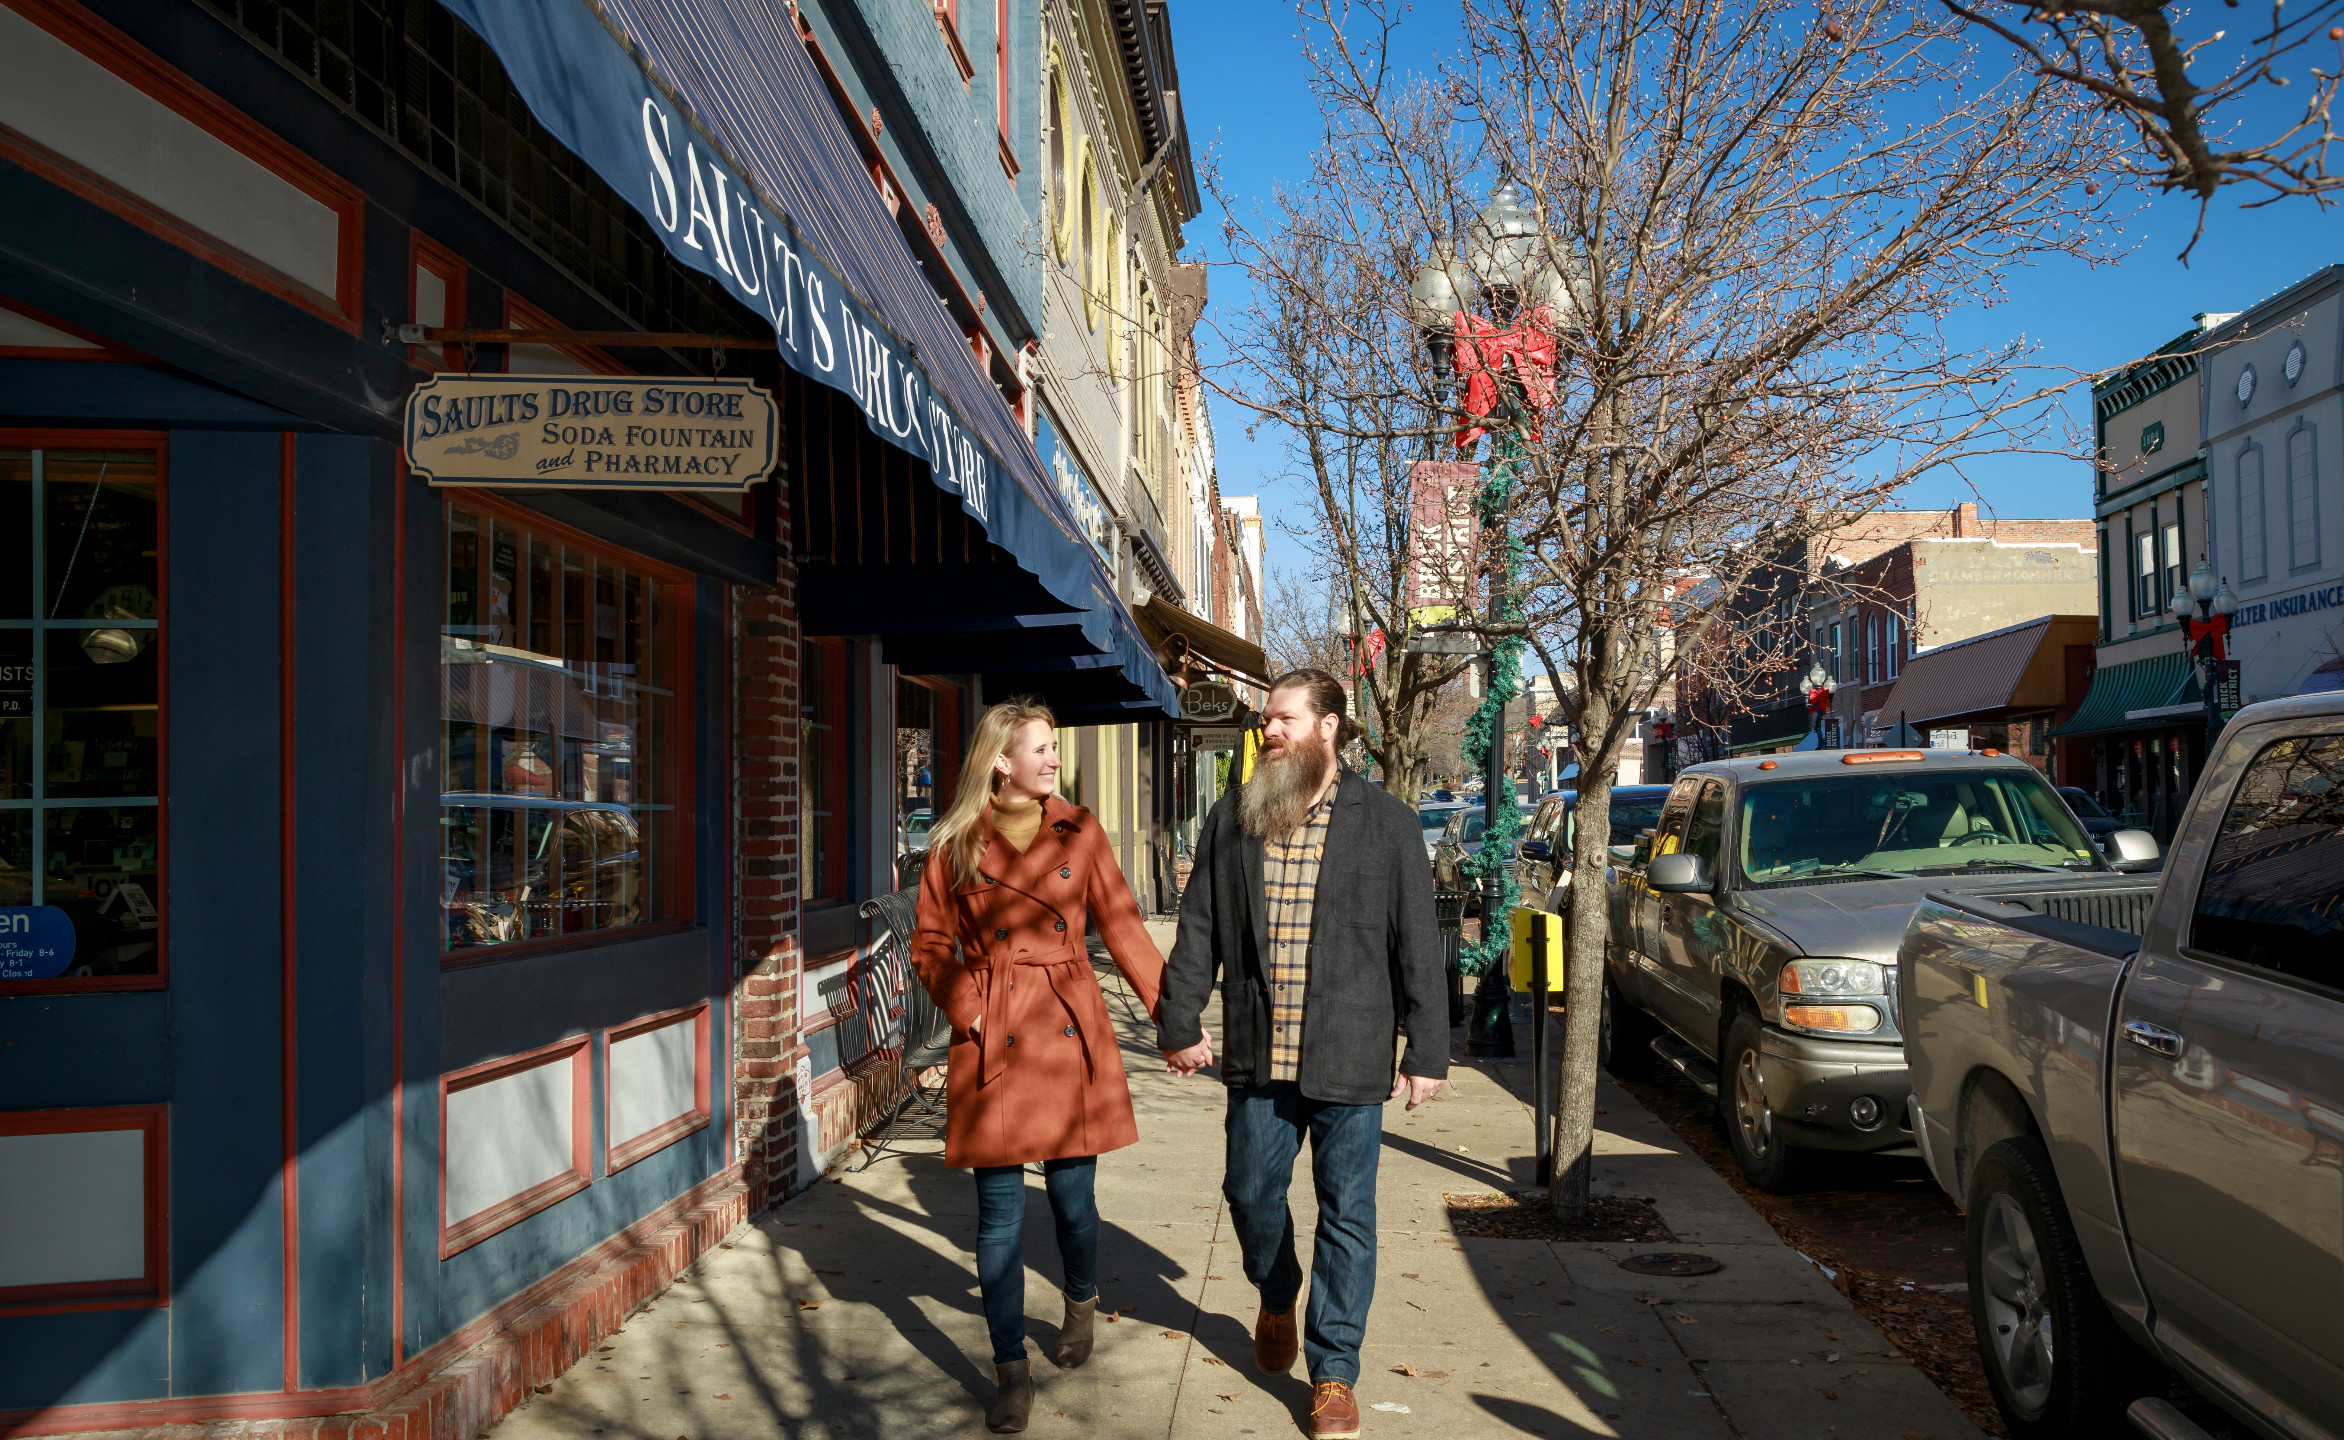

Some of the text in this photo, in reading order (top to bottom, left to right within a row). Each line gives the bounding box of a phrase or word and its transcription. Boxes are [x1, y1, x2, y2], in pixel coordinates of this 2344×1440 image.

[643, 98, 835, 373] SAULTS
[417, 388, 746, 440] SAULTS DRUG STORE
[541, 422, 754, 449] SODA FOUNTAIN
[535, 448, 742, 475] and PHARMACY
[2269, 585, 2344, 621] INSURANCE
[1186, 689, 1229, 714] Beks
[2220, 682, 2230, 709] BRICK
[2228, 668, 2239, 709] DISTRICT
[6, 950, 33, 958] Friday
[39, 949, 55, 957] 8-6
[9, 958, 23, 967] 8-1
